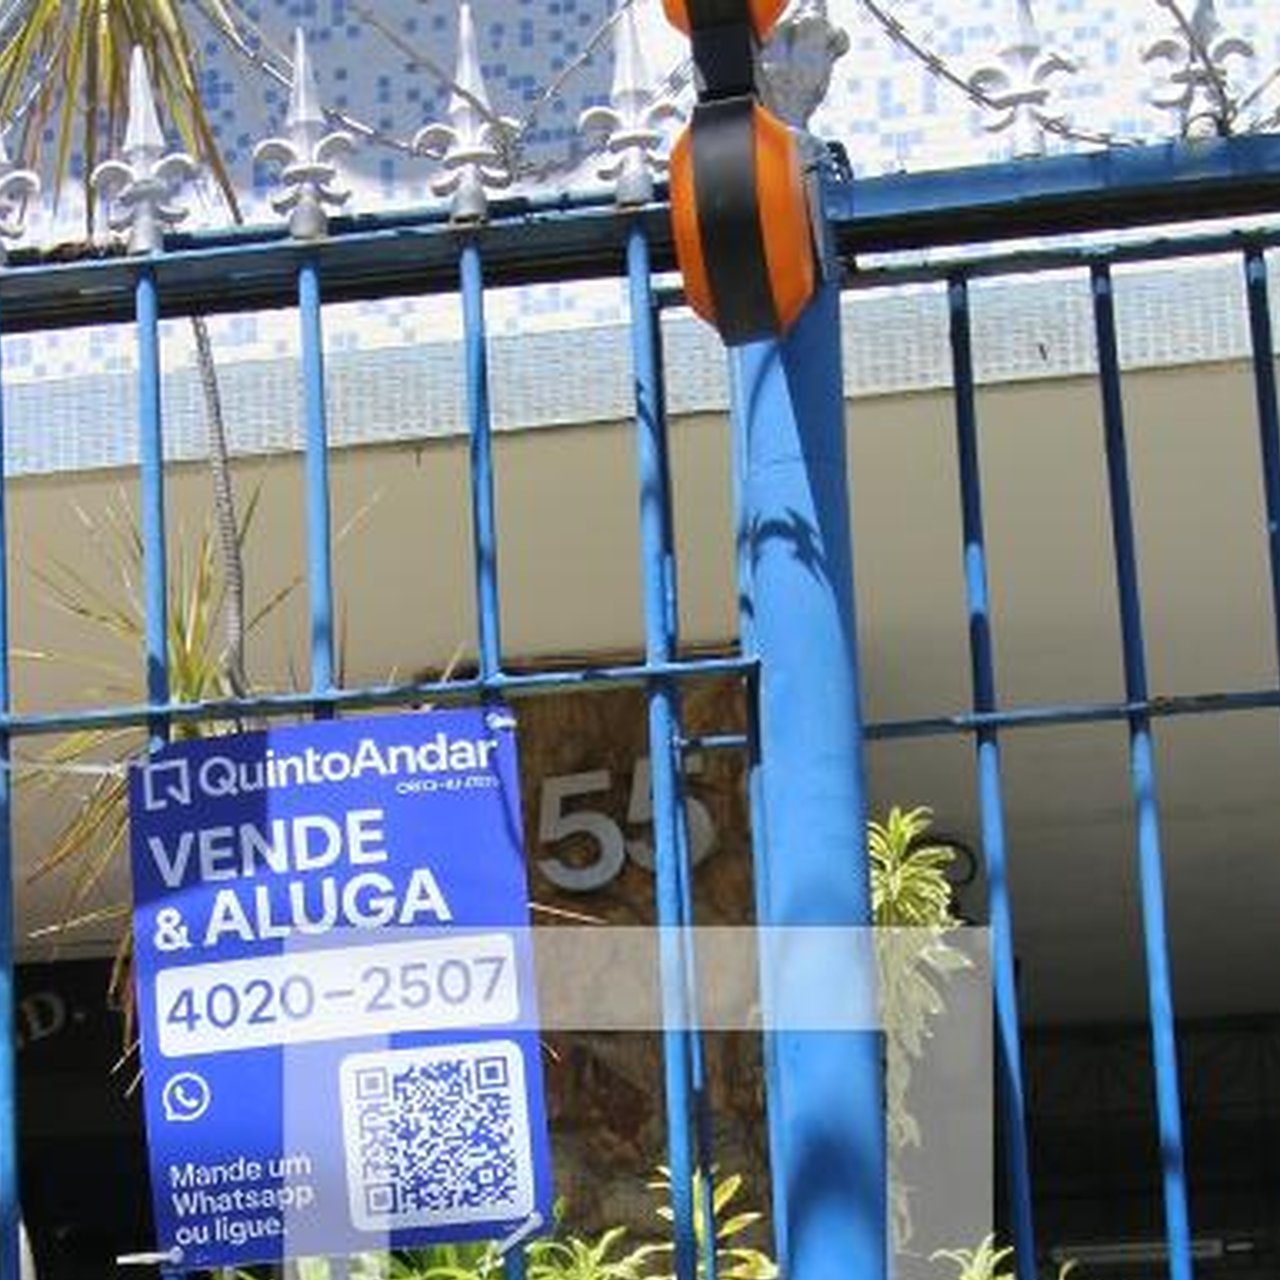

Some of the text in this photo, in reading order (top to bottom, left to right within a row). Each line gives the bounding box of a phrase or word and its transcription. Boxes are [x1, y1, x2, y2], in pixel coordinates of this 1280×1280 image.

[199, 734, 498, 796] QuintoAndar
[149, 809, 388, 888] VENDE
[154, 868, 453, 951] & ALUGA
[166, 955, 507, 1032] 4020-2507
[170, 1155, 312, 1188] Mande um
[172, 1185, 314, 1217] Whatsapp
[176, 1216, 288, 1245] ou ligue.
